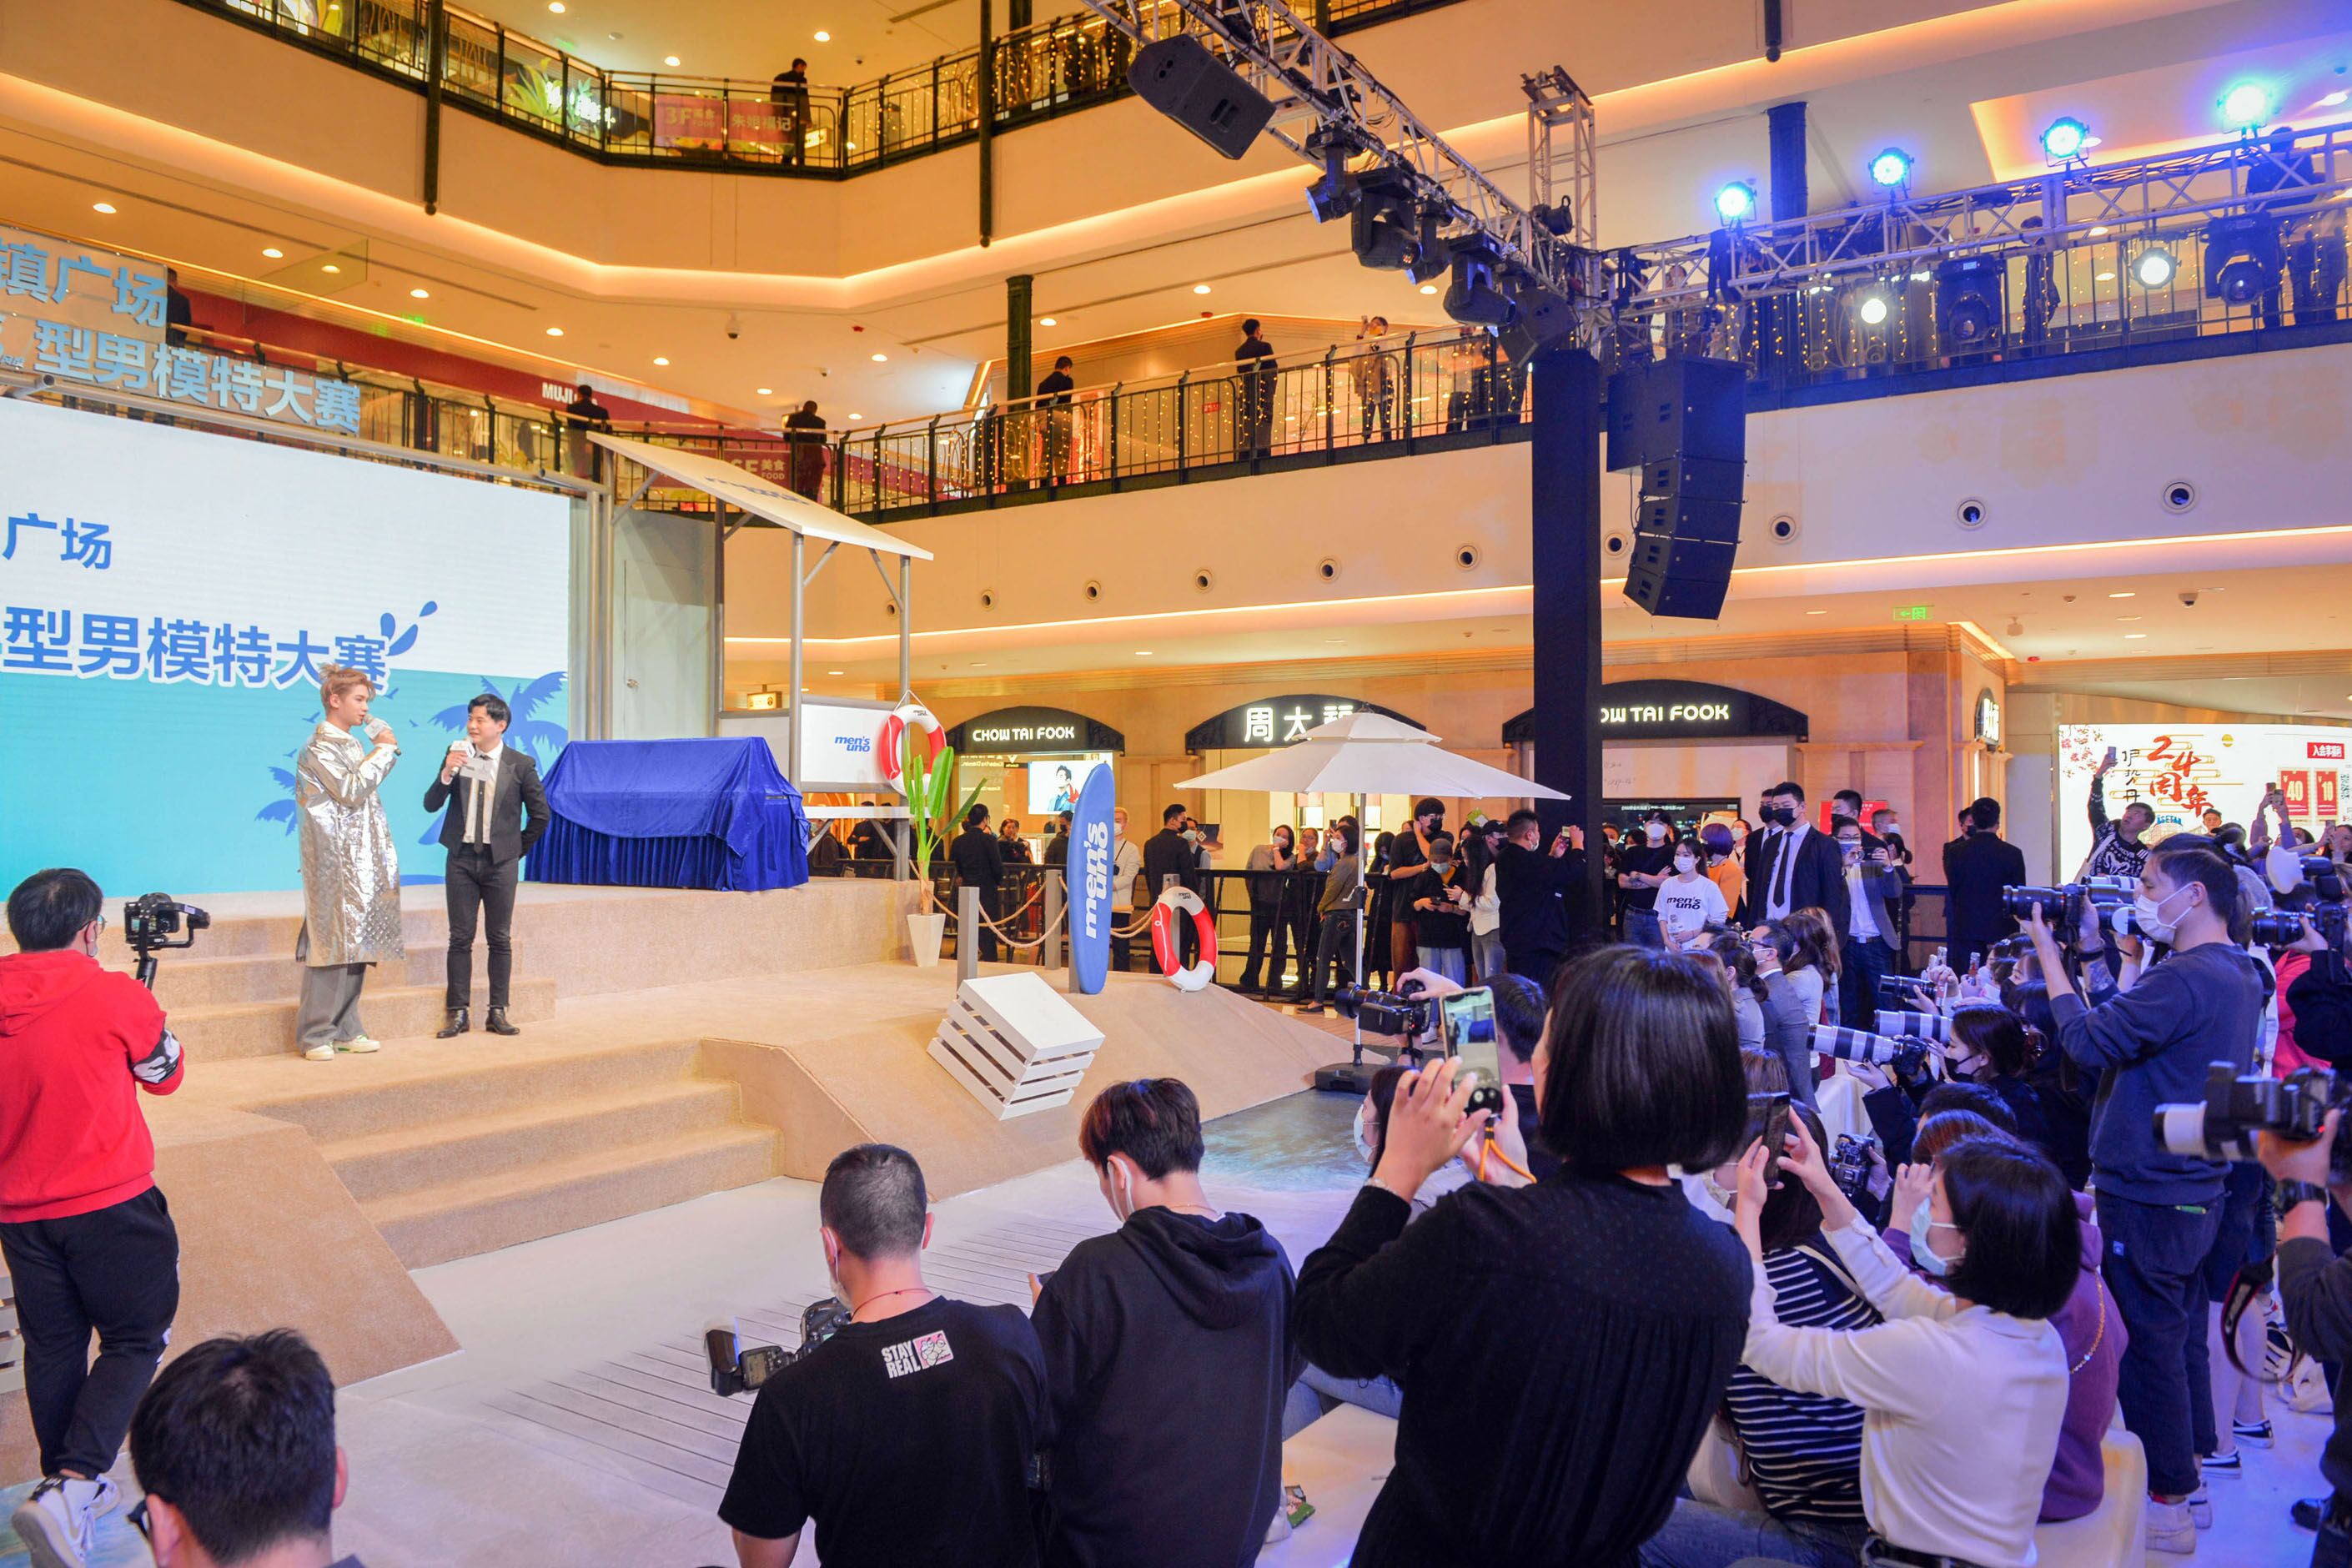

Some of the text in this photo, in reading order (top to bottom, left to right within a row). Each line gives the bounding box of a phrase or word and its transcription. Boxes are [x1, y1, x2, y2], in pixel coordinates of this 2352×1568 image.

[34, 320, 360, 431] 型男模特大赛
[542, 382, 573, 405] MUJI
[761, 471, 785, 480] FOOD
[3, 513, 112, 570] 广场
[3, 606, 388, 691] 型男模特大赛
[1630, 706, 1664, 722] TAI
[1670, 704, 1729, 721] FOOK
[835, 736, 871, 745] men's
[972, 726, 1075, 742] CHOW TAI FOOK
[846, 743, 870, 752] uno
[2148, 735, 2202, 777] 24
[2286, 781, 2304, 802] 40
[2321, 781, 2334, 802] 10
[1096, 822, 1108, 900] uno
[1083, 822, 1098, 939] men's
[1666, 897, 1701, 905] men's
[881, 1341, 913, 1362] STAY
[886, 1356, 922, 1379] REAL
